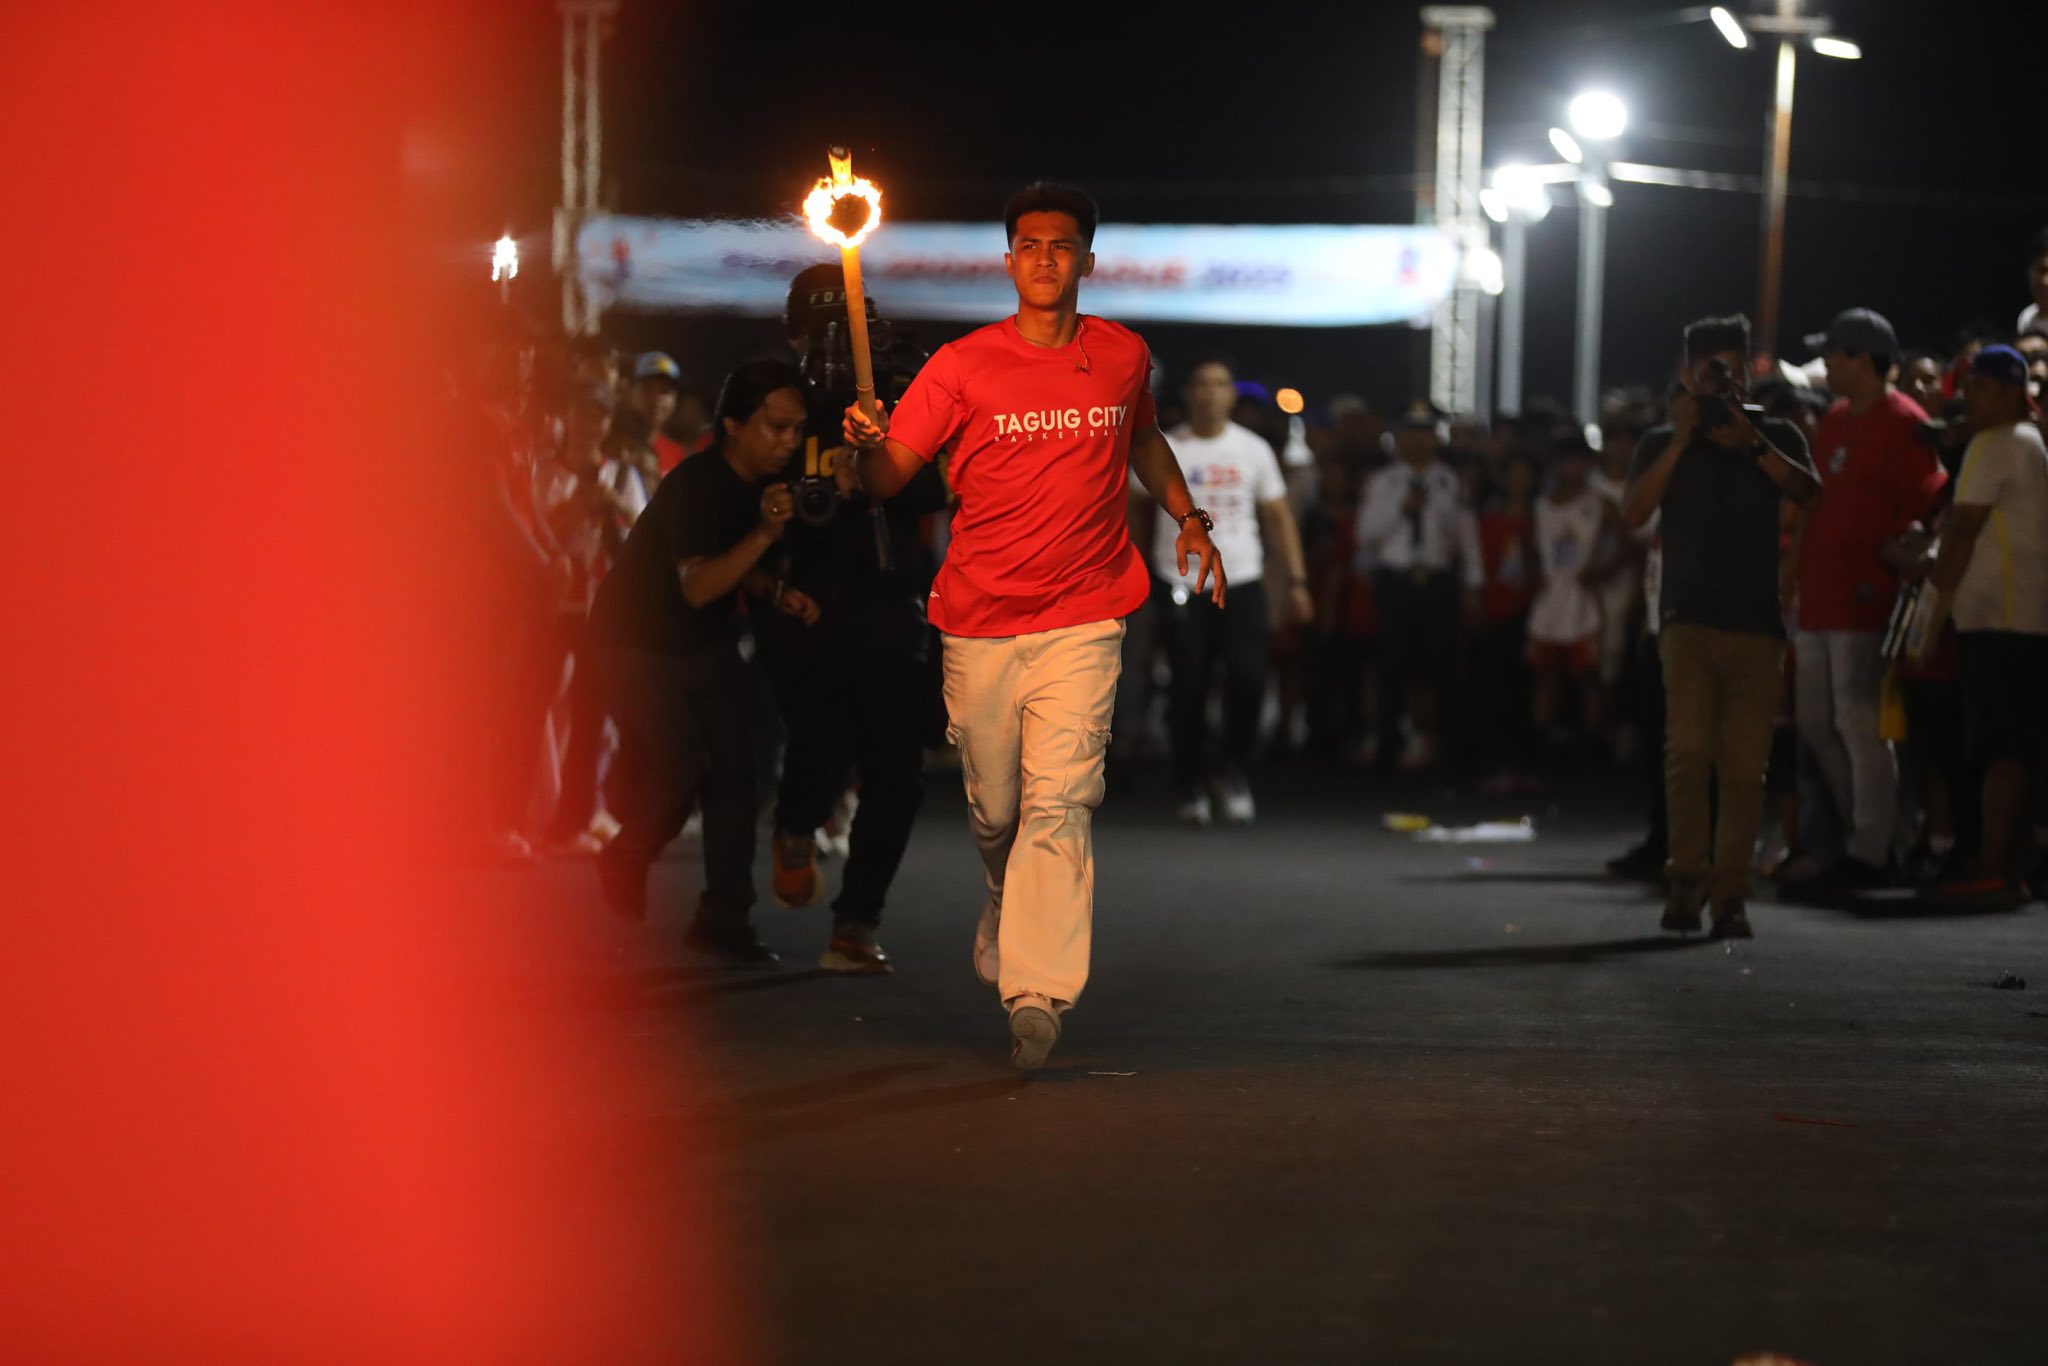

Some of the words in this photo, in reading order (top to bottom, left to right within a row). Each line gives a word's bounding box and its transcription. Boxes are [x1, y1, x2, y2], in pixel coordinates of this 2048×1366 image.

[810, 291, 846, 305] FO
[993, 408, 1081, 434] TAGUIG
[1087, 406, 1127, 428] CITY
